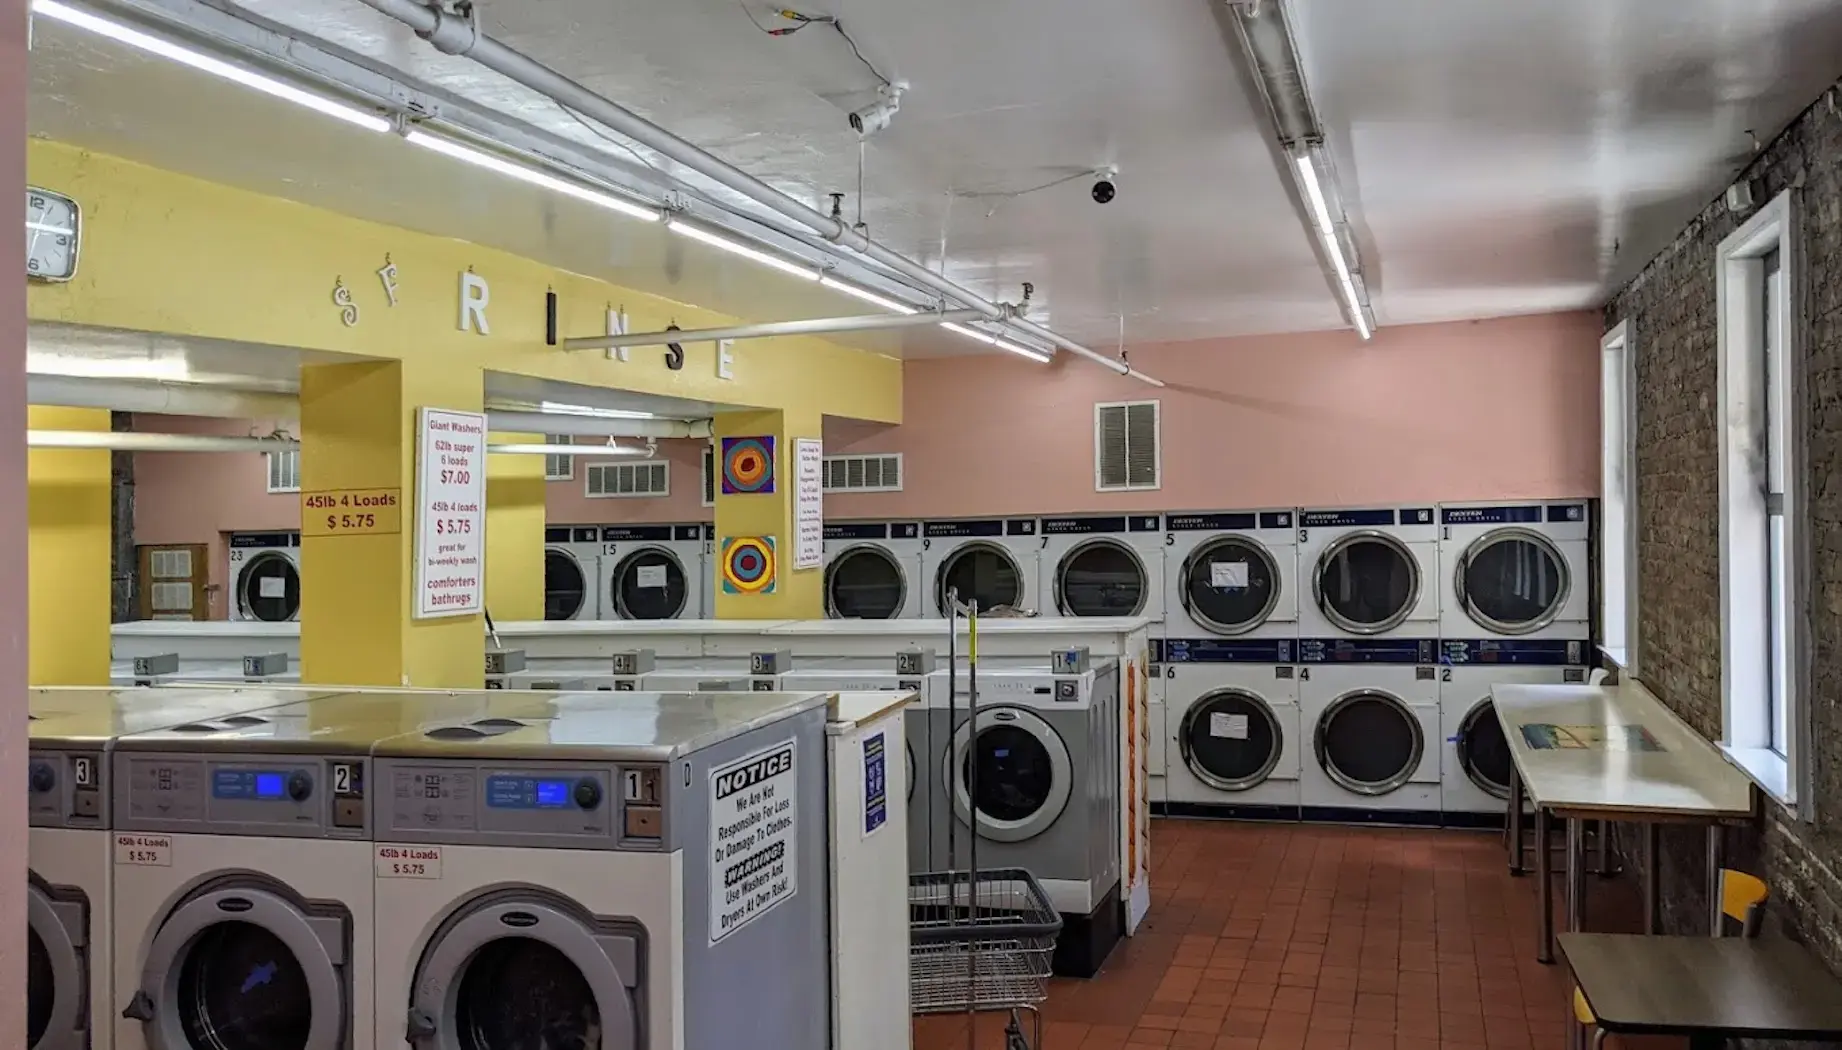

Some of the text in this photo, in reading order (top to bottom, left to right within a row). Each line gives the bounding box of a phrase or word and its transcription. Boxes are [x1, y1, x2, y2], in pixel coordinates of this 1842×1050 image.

[30, 196, 44, 210] 12
[56, 233, 67, 246] 3
[28, 258, 39, 270] 6
[430, 420, 481, 434] Giant Washers
[435, 440, 474, 453] 62lb super
[441, 455, 468, 466] 6 loads
[440, 469, 470, 484] $7.00
[306, 493, 396, 508] 45lb 4 Loads
[431, 501, 478, 512] 45lb 4 loads
[327, 514, 374, 530] $ 5.75
[437, 519, 471, 534] $ 5.75
[1166, 533, 1175, 546] 5
[1299, 530, 1308, 543] 3
[1443, 527, 1449, 540] 1
[438, 542, 466, 554] great for
[924, 539, 931, 551] 9
[1041, 536, 1049, 549] 7
[231, 550, 243, 561] 23
[603, 544, 617, 555] 15
[427, 576, 476, 589] comforters
[431, 592, 471, 606] bathrugs
[246, 659, 251, 670] 7
[486, 656, 492, 669] 5
[616, 657, 622, 668] 4
[755, 656, 761, 669] 3
[901, 656, 907, 669] 2
[1167, 667, 1175, 679] 6
[1300, 668, 1309, 681] 4
[1442, 669, 1451, 682] 2
[78, 761, 86, 782] 3
[717, 752, 790, 799] NOTICE
[337, 768, 348, 792] 2
[630, 773, 637, 799] 1
[736, 784, 774, 812] We Are Not
[719, 799, 789, 841] Responsible For Loss
[118, 837, 168, 848] 45lb 4 Loads
[715, 848, 724, 862] Or
[726, 834, 755, 858] Damage
[756, 828, 765, 841] To
[129, 850, 157, 861] $ 5.75
[380, 848, 438, 860] 45lb 4 Loads
[393, 863, 425, 875] $ 5.75
[726, 860, 783, 905] Use Washers And
[721, 906, 745, 929] Dryers
[746, 897, 754, 913] At
[755, 891, 770, 908] Own
